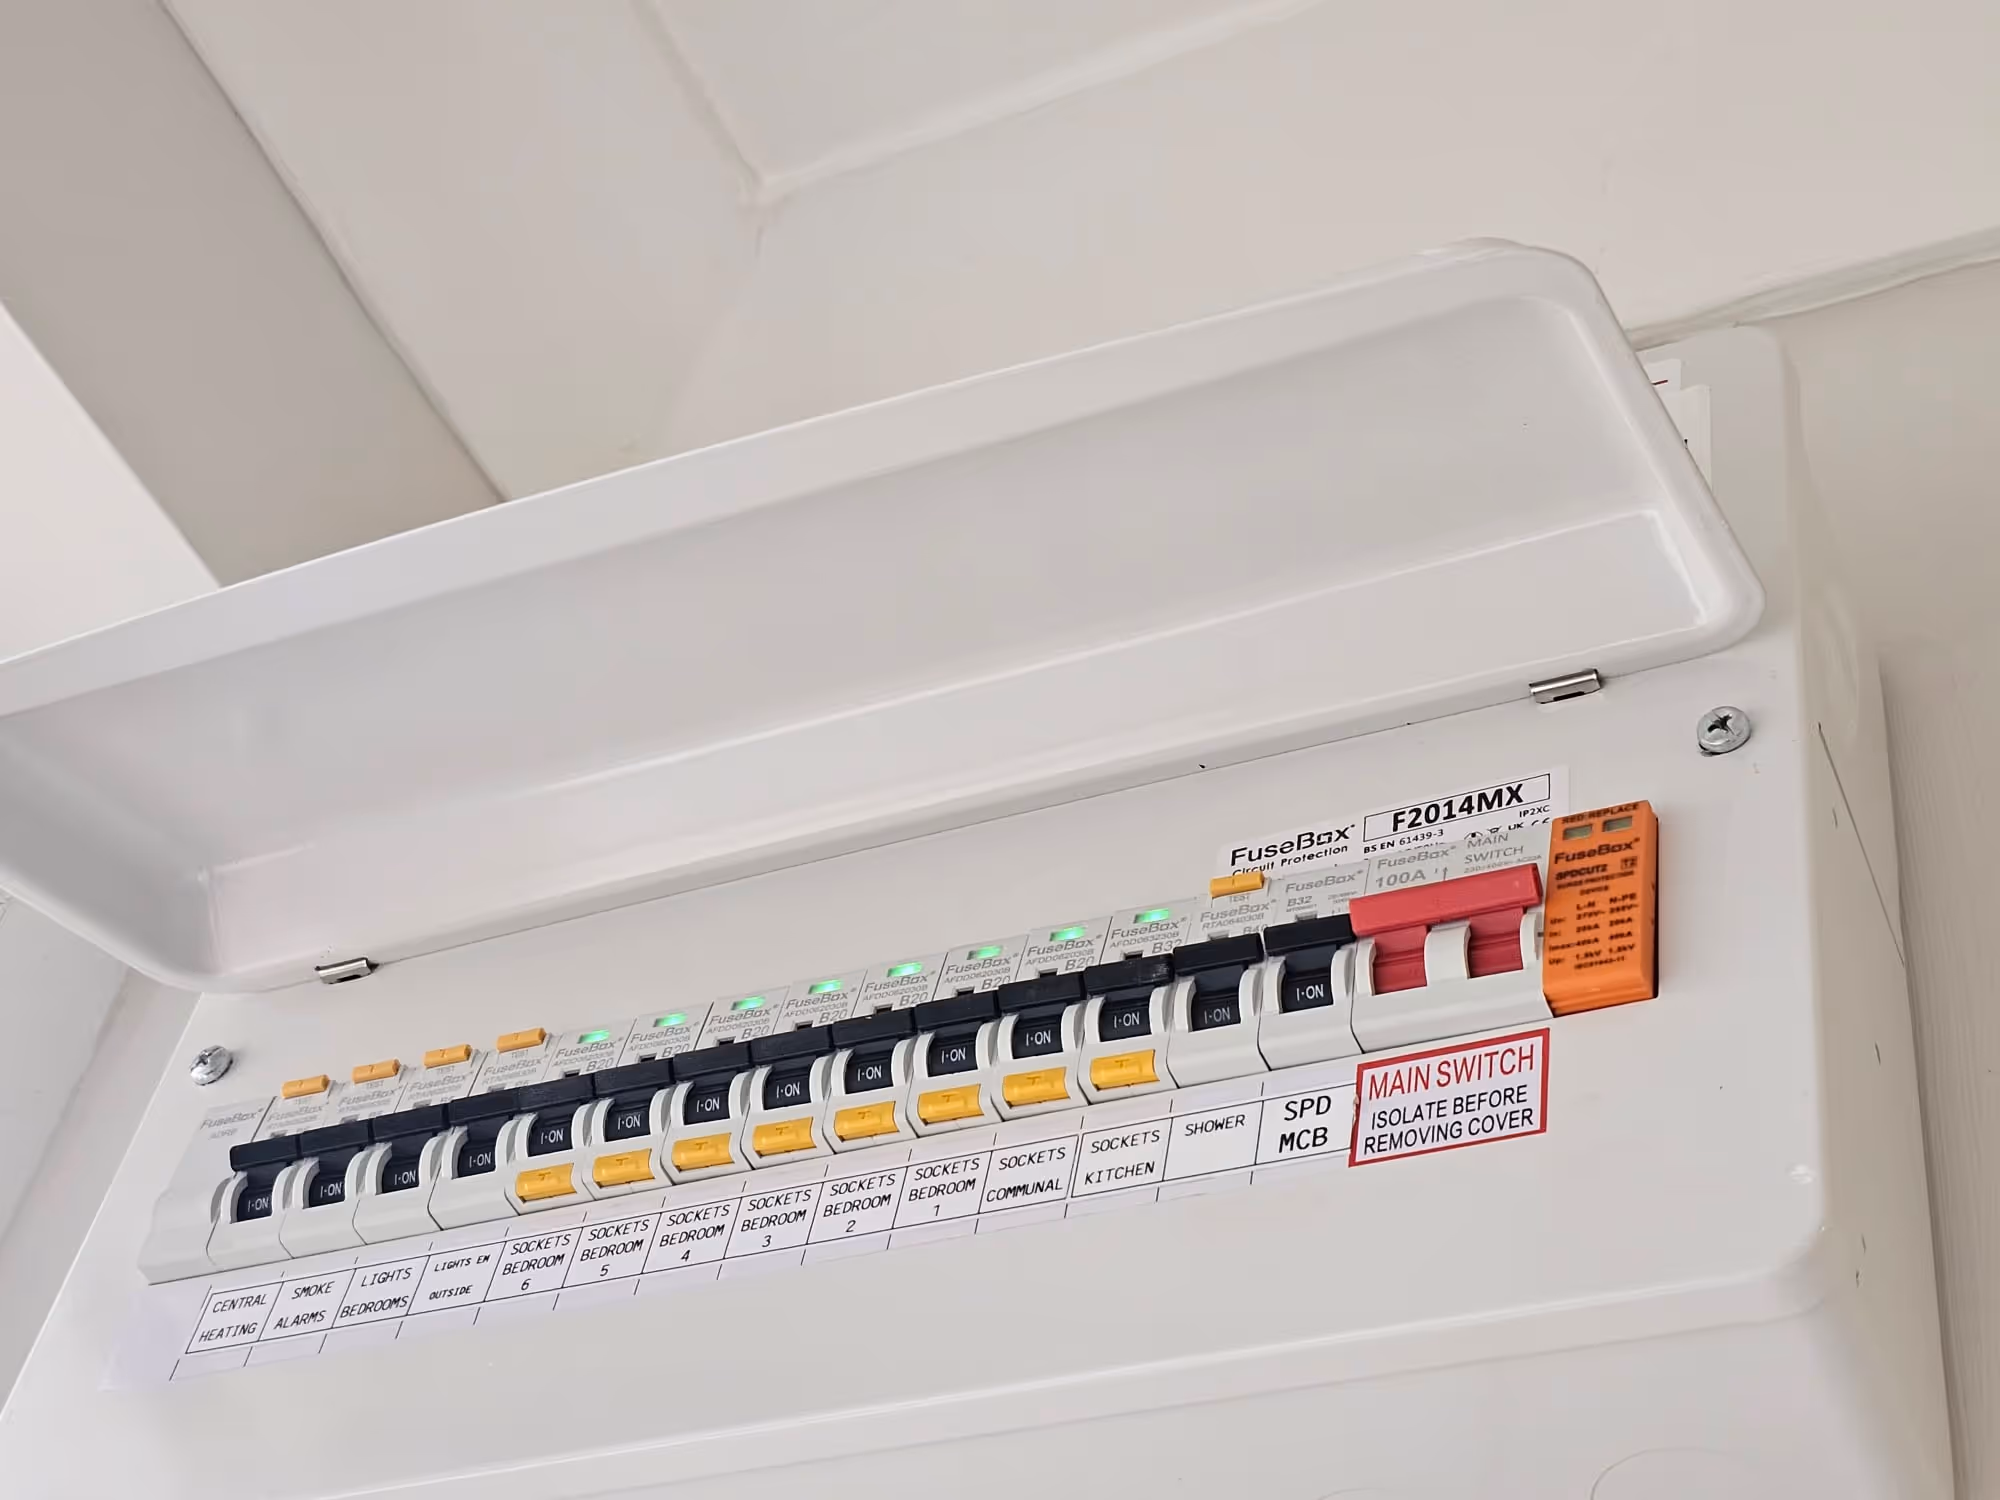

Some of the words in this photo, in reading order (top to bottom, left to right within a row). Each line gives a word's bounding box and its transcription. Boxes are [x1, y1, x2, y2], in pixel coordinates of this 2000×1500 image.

[1392, 783, 1524, 833] F2014MX
[1519, 805, 1550, 818] IP2XC
[1231, 825, 1352, 866] FuseBox
[1363, 844, 1377, 854] BS
[1380, 840, 1395, 850] EN
[1399, 829, 1444, 846] 61439-3
[1467, 833, 1509, 849] MAIN
[1281, 845, 1348, 867] Protection
[1377, 847, 1450, 869] FuseBox
[1464, 846, 1524, 865] SWITCH
[1554, 841, 1634, 864] FuseBox
[1285, 873, 1356, 893] FuseBox
[1376, 869, 1426, 888] 100A
[1287, 896, 1312, 908] B32
[1200, 903, 1270, 923] FuseBox
[1111, 917, 1180, 939] FuseBox
[1027, 938, 1096, 957] FuseBox
[1152, 939, 1183, 955] B32
[945, 957, 1012, 975] FuseBox
[1065, 955, 1096, 972] B20
[864, 974, 929, 993] FuseBox
[981, 976, 1011, 991] B20
[785, 991, 849, 1010] FuseBox
[899, 992, 929, 1007] B20
[709, 1007, 772, 1026] FuseBox
[819, 1009, 848, 1025] B20
[630, 1026, 691, 1044] FuseBox
[741, 1024, 771, 1041] B20
[556, 1041, 617, 1059] FuseBox
[661, 1043, 690, 1058] B20
[586, 1057, 614, 1072] B20
[1368, 1063, 1431, 1101] MAIN
[1436, 1044, 1534, 1088] SWITCH
[1284, 1095, 1332, 1121] SPD
[1371, 1099, 1448, 1130] ISOLATE
[1453, 1084, 1528, 1115] BEFORE
[1184, 1114, 1246, 1137] SHOWER
[1364, 1121, 1463, 1155] REMOVING
[1468, 1108, 1534, 1136] COVER
[1091, 1129, 1160, 1154] SOCKETS
[1278, 1126, 1328, 1153] MCB
[998, 1146, 1066, 1170] SOCKETS
[914, 1157, 980, 1181] SOCKETS
[1084, 1161, 1155, 1185] KITCHEN
[830, 1173, 896, 1197] SOCKETS
[908, 1178, 977, 1202] BEDROOM
[986, 1178, 1063, 1203] COMMUNAL
[747, 1189, 812, 1212] SOCKETS
[823, 1193, 892, 1218] BEDROOM
[933, 1204, 940, 1217] 1
[666, 1204, 731, 1227] SOCKETS
[740, 1209, 807, 1233] BEDROOM
[588, 1218, 650, 1242] SOCKETS
[659, 1223, 726, 1248] BEDROOM
[845, 1219, 856, 1233] 2
[510, 1233, 572, 1256] SOCKETS
[580, 1238, 644, 1262] BEDROOM
[761, 1234, 772, 1248] 3
[434, 1257, 472, 1272] LIGHTS
[502, 1252, 565, 1276] BEDROOM
[680, 1249, 691, 1262] 4
[361, 1267, 413, 1287] LIGHTS
[599, 1263, 610, 1277] 5
[291, 1281, 336, 1300] SMOKE
[429, 1285, 473, 1300] OUTSIDE
[520, 1278, 532, 1291] 6
[212, 1294, 267, 1313] CENTRAL
[340, 1295, 409, 1318] BEDROOMS
[273, 1310, 327, 1330] ALARMS
[198, 1322, 258, 1343] HEATING
